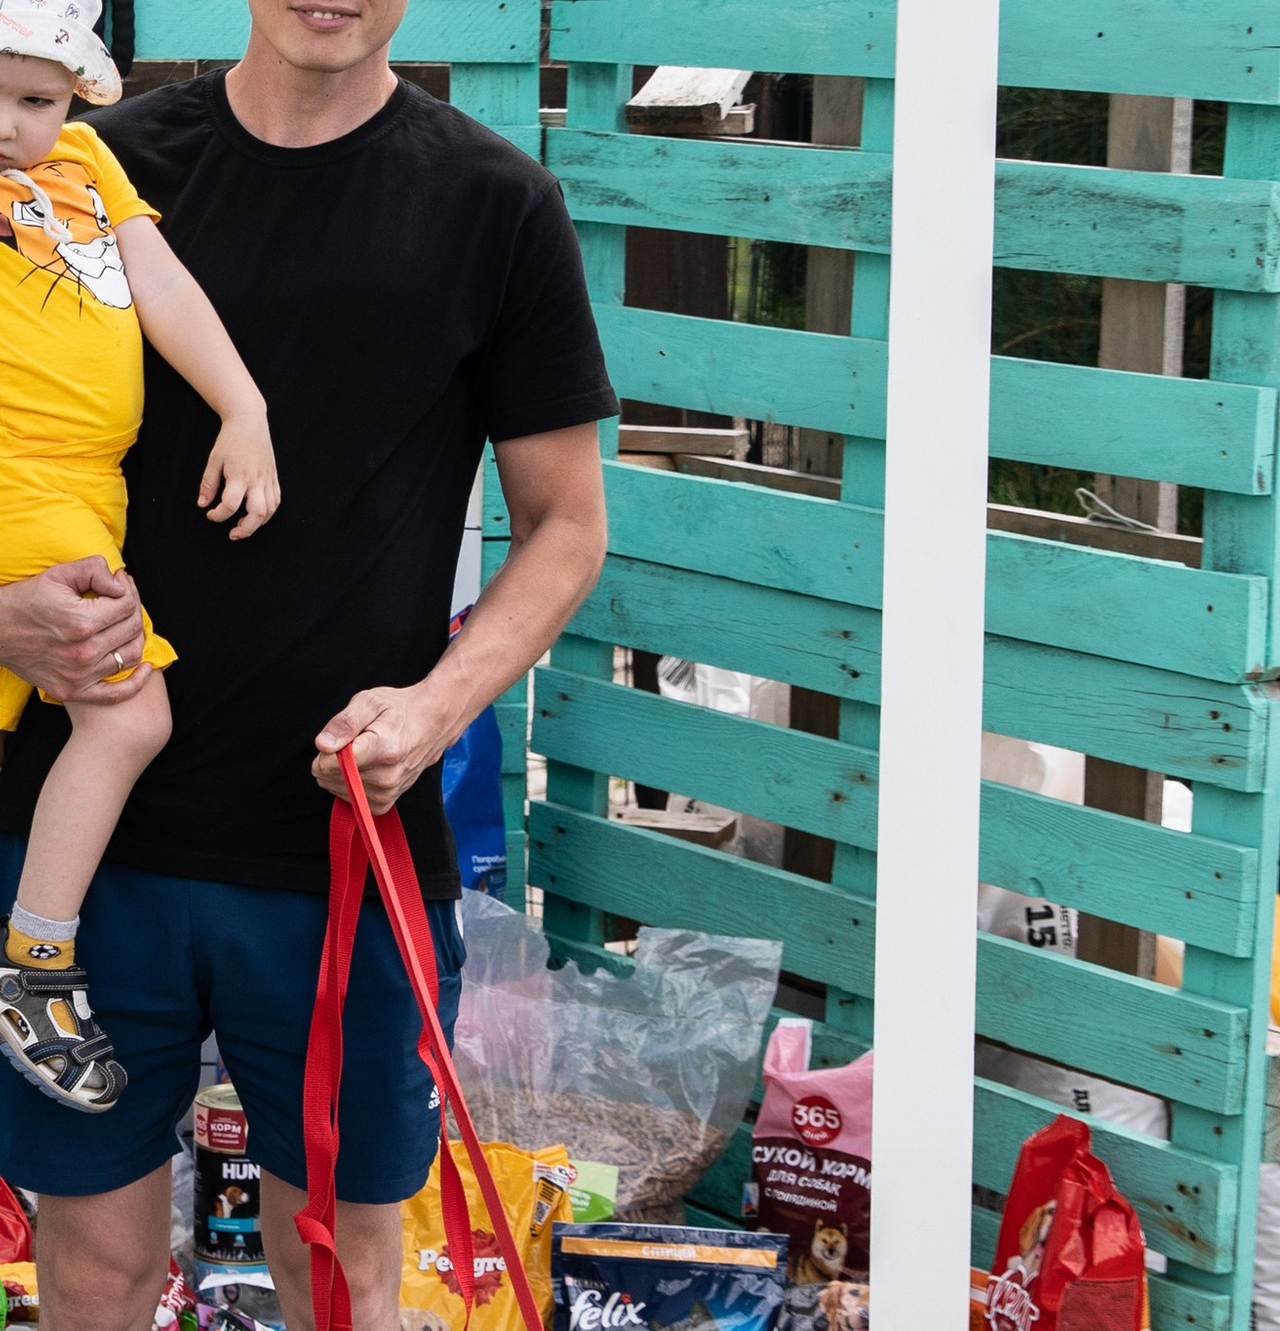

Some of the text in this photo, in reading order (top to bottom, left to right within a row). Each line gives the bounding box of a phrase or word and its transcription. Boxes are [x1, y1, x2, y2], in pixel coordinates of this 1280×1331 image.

[1024, 904, 1058, 949] 15
[209, 1122, 242, 1135] КОРМ
[793, 1103, 841, 1130] 365
[222, 1162, 261, 1180] HUN
[751, 1146, 872, 1189] СУХОЙ КОРМ
[766, 1169, 841, 1197] ДЛЯ СОБАК
[417, 1248, 507, 1278] Pegre
